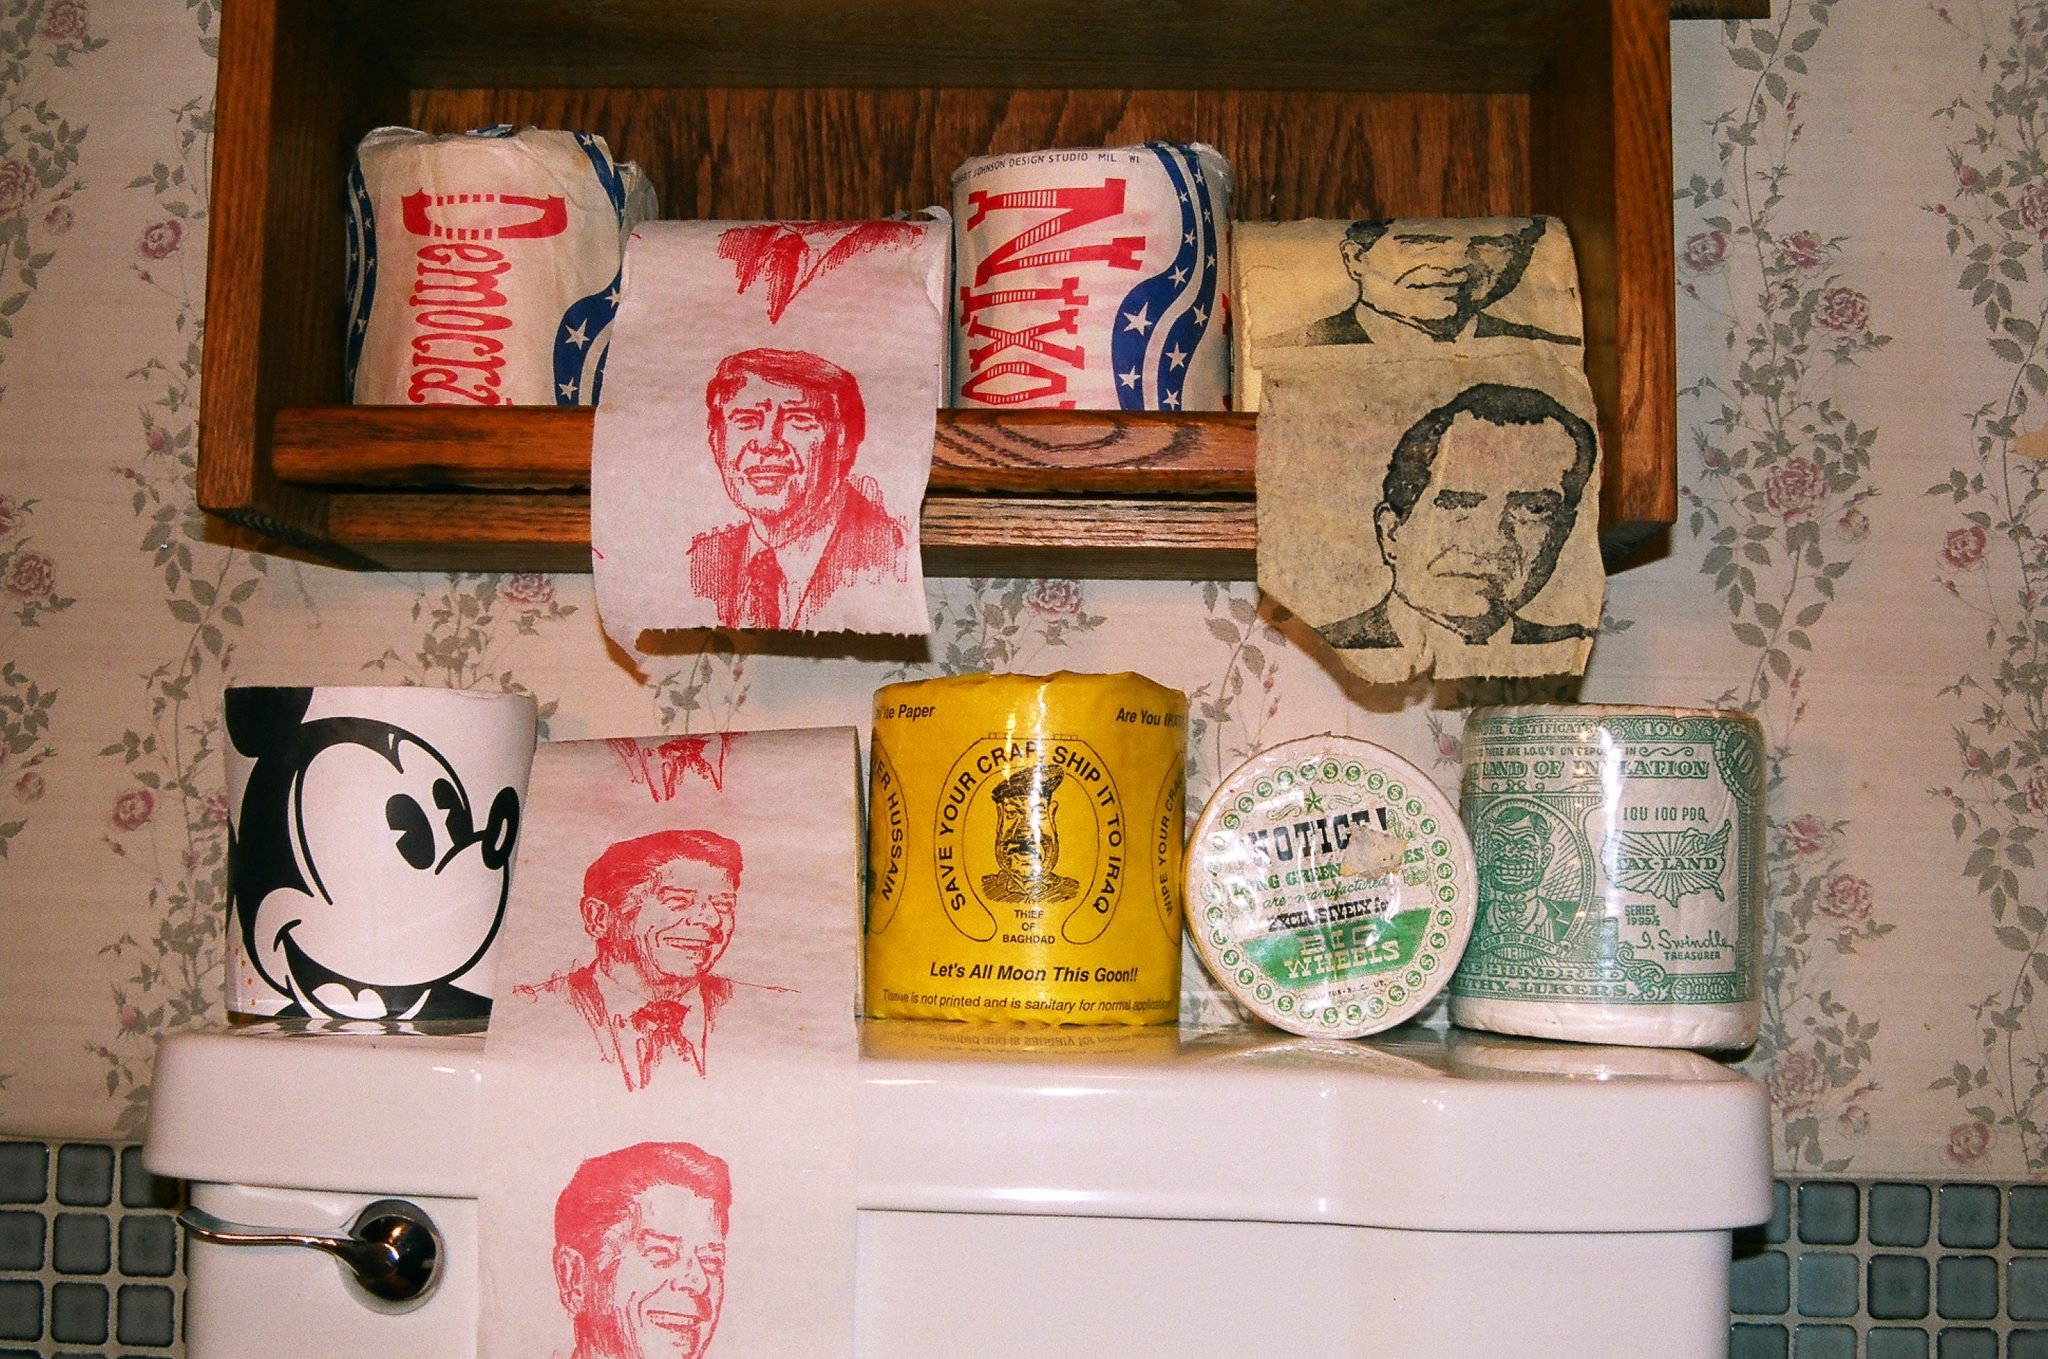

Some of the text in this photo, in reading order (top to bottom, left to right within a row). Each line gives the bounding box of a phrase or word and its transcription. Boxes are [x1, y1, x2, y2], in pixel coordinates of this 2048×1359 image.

[973, 159, 1005, 178] JOHNSON
[1009, 155, 1045, 169] DESIGN
[1048, 152, 1088, 163] STUDIO
[401, 187, 568, 406] Democra
[960, 178, 1146, 409] NIXO
[898, 704, 935, 721] Paper
[1116, 707, 1137, 723] Are
[1141, 710, 1161, 725] You
[1643, 722, 1685, 737] 100
[1561, 746, 1574, 756] ON
[1625, 746, 1637, 756] IN
[1052, 745, 1101, 782] SHIP
[1481, 760, 1529, 779] LAND
[1533, 760, 1565, 779] OF
[1573, 759, 1709, 779] INLATION
[940, 771, 977, 836] YOUR
[1097, 785, 1115, 807] IT
[1655, 807, 1677, 821] 100
[1682, 807, 1709, 823] PDQ
[1107, 813, 1122, 847] TO
[1158, 815, 1170, 867] YOUR
[881, 792, 903, 901] HUSSAIN
[938, 846, 966, 911] SAVE
[1093, 856, 1121, 914] IRAQ
[1159, 872, 1173, 917] WIPE
[1263, 877, 1389, 910] are manufactured
[1014, 909, 1044, 919] THIEF
[1624, 904, 1656, 916] SERIES
[1021, 922, 1036, 931] OF
[1002, 934, 1056, 944] BAGHDAD
[1524, 935, 1556, 952] SHOT
[1658, 929, 1735, 952] Swindle
[1283, 940, 1400, 979] WHEELS
[1663, 951, 1721, 961] TREASURER
[930, 961, 1139, 983] Let's All Moon This Goon!!
[1487, 964, 1626, 982] HUNDRED
[883, 989, 909, 1003] Tissue
[911, 992, 919, 1004] is
[921, 994, 938, 1006] not
[939, 994, 981, 1008] printed
[984, 997, 1008, 1008] and
[1011, 998, 1021, 1009] is
[1024, 998, 1076, 1013] sanitary
[1078, 999, 1095, 1011] for
[1098, 1000, 1131, 1011] normal
